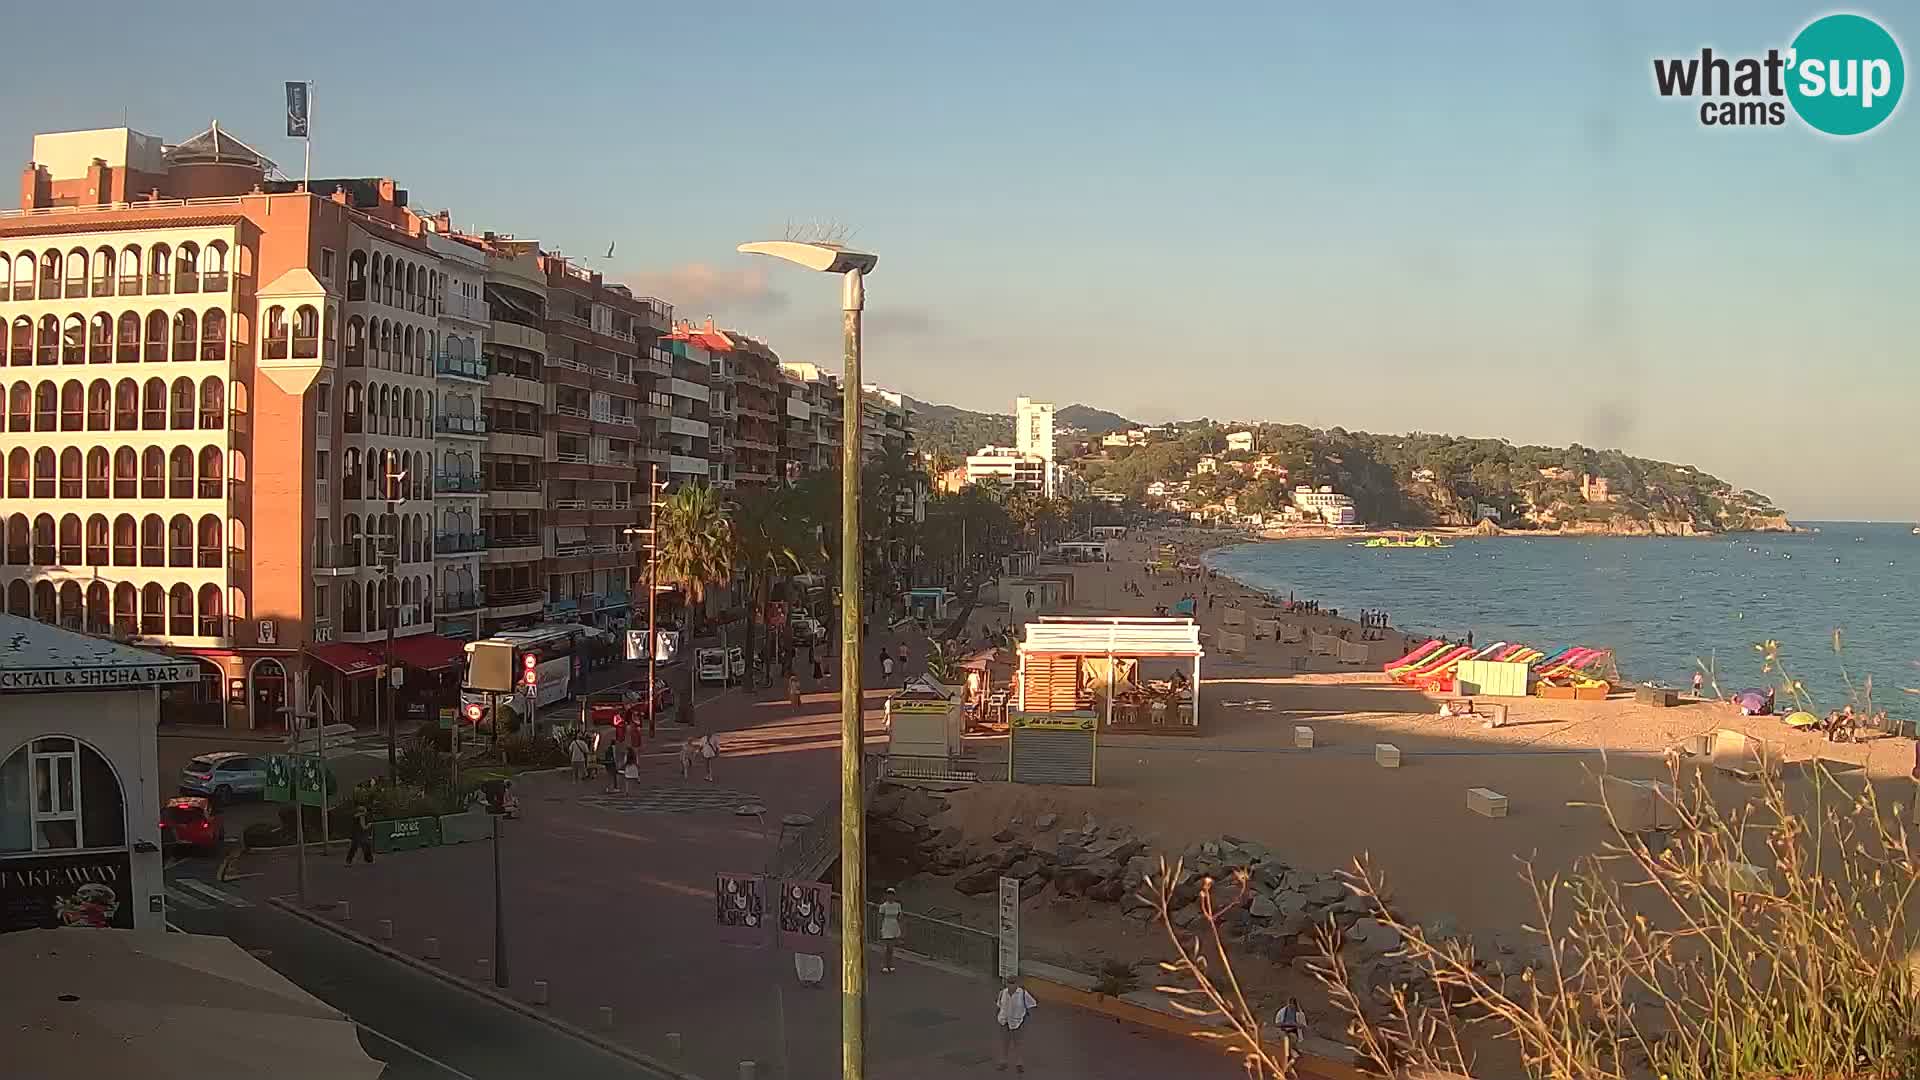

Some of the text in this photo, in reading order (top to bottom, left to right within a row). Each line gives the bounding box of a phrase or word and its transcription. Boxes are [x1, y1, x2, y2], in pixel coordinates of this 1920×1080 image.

[315, 627, 333, 643] KFC
[64, 672, 76, 685] &
[80, 669, 141, 685] SHISHA
[147, 667, 180, 682] BAR
